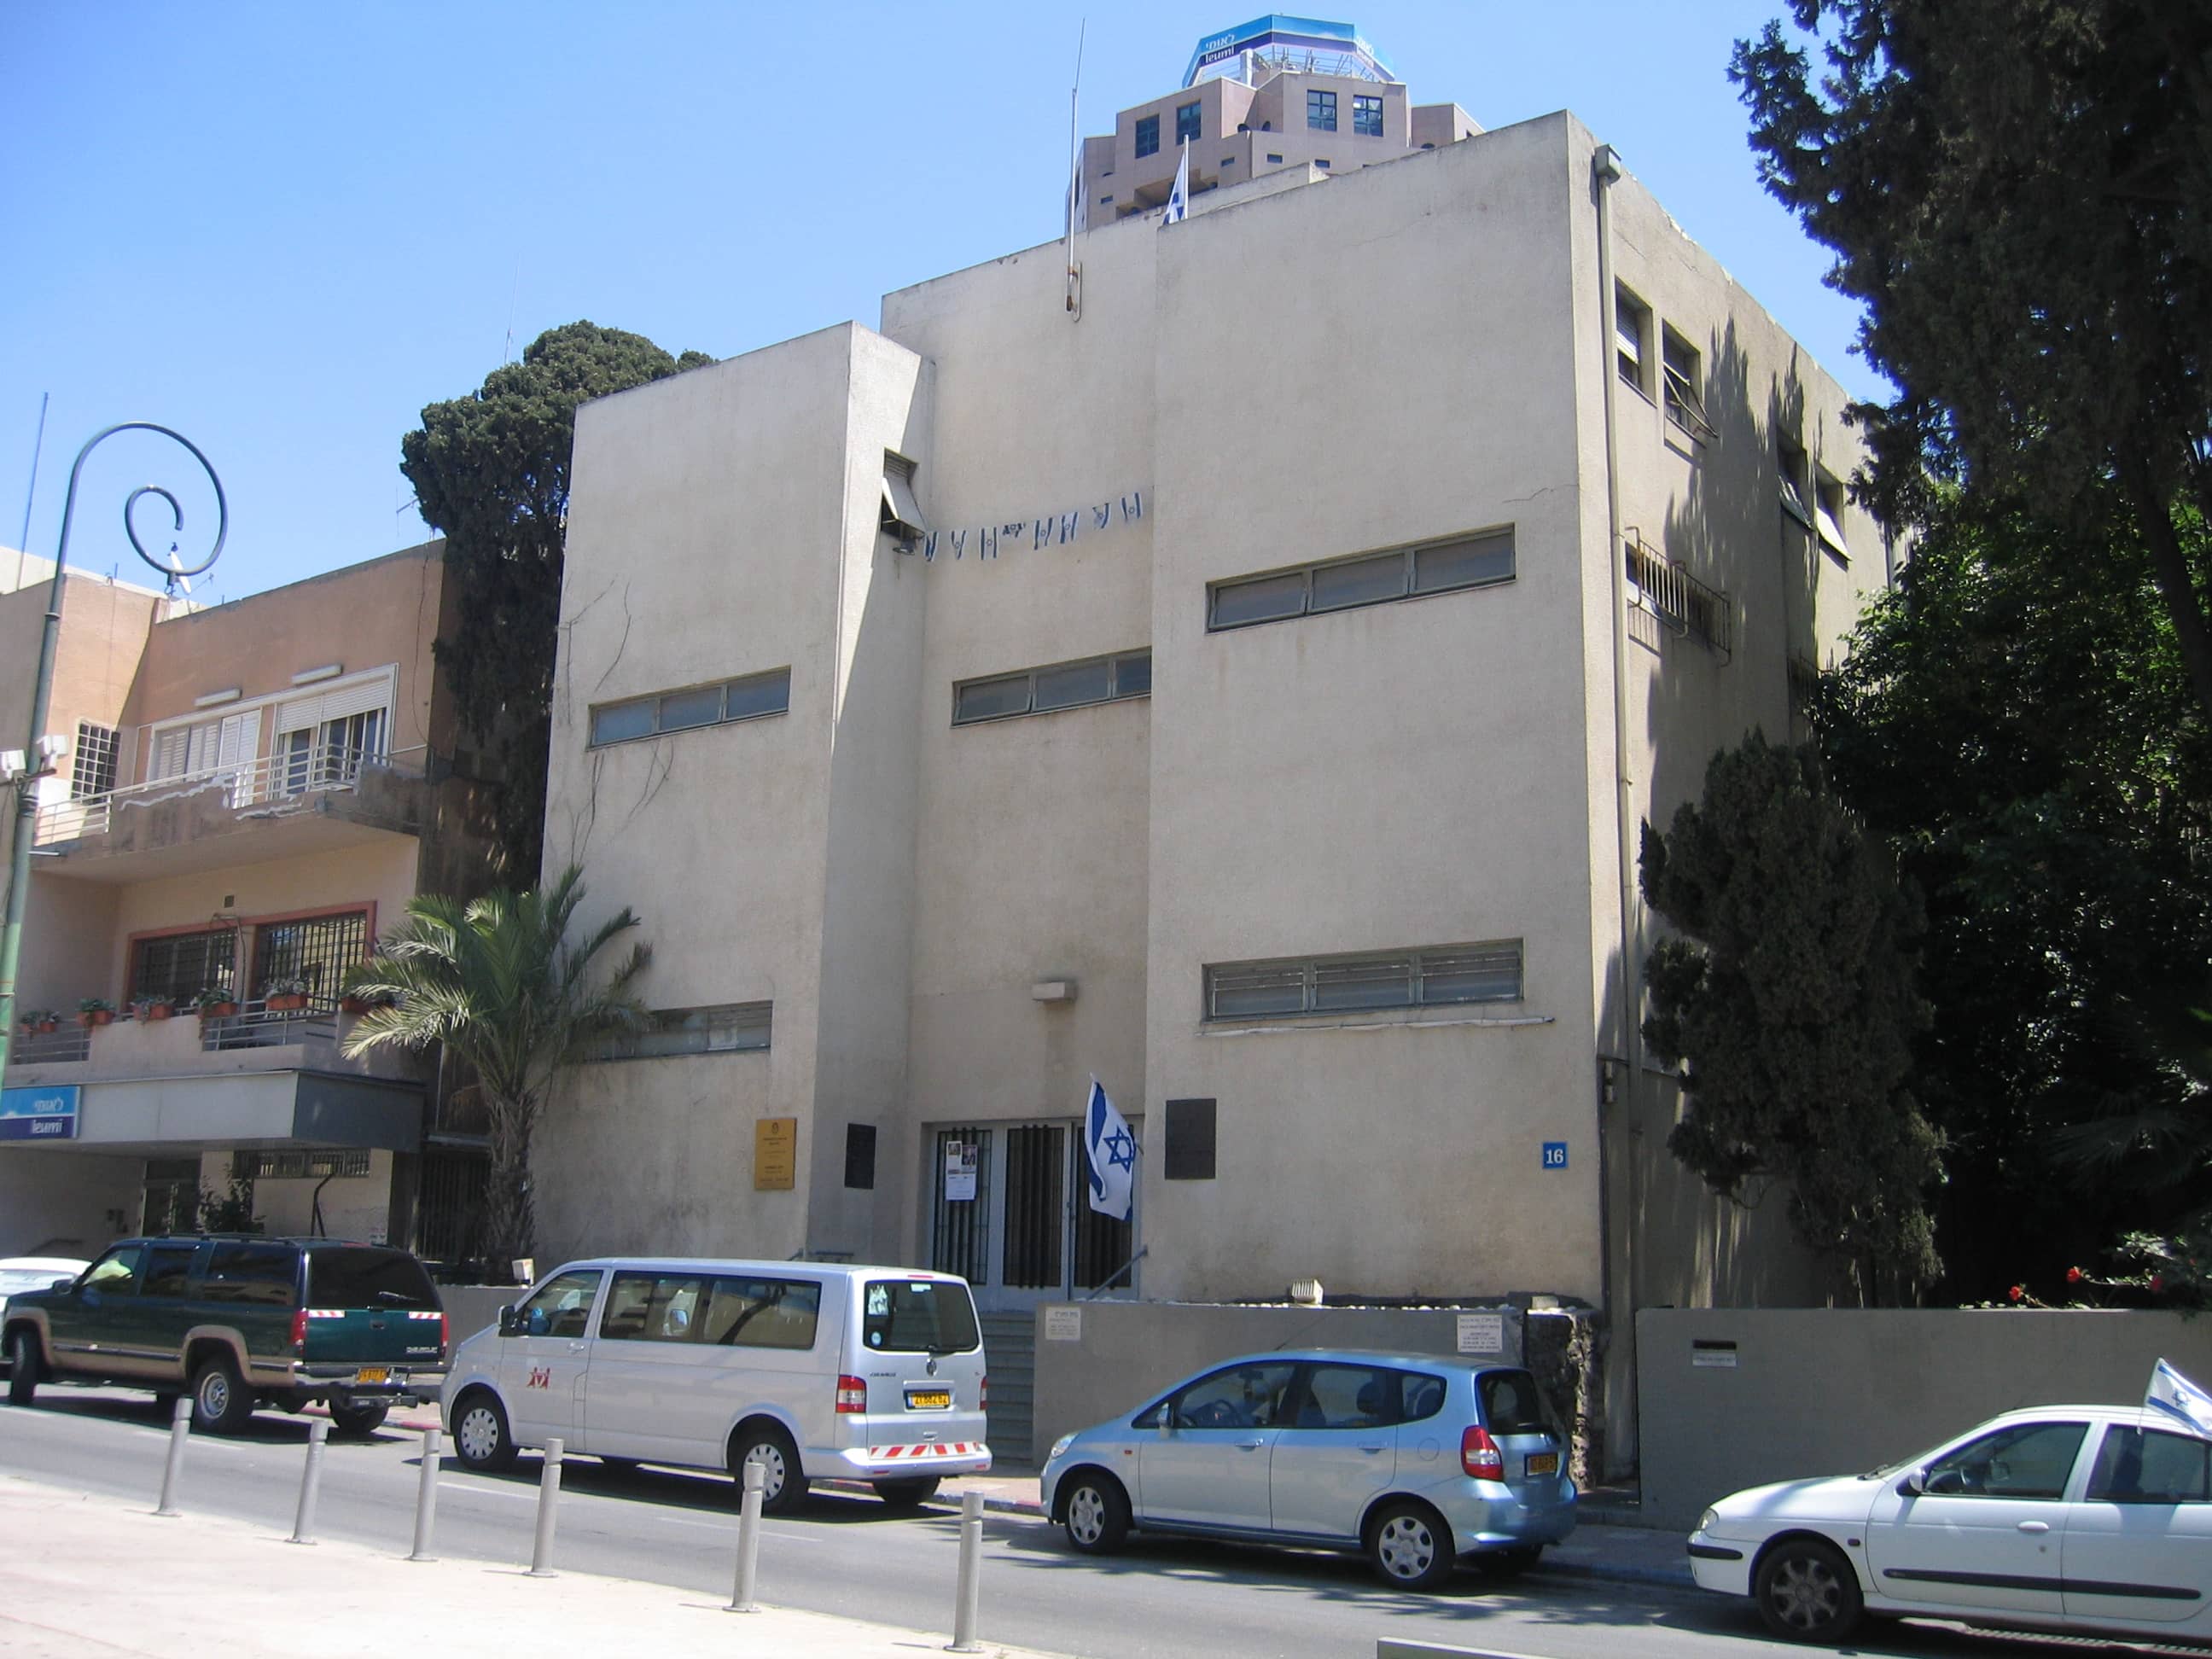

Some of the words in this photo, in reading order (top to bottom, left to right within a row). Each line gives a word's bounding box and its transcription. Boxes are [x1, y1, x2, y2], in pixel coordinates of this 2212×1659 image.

[1205, 33, 1236, 50] לאומי
[1205, 45, 1235, 64] leumi
[32, 1119, 63, 1134] leumi
[1545, 1148, 1564, 1164] 16
